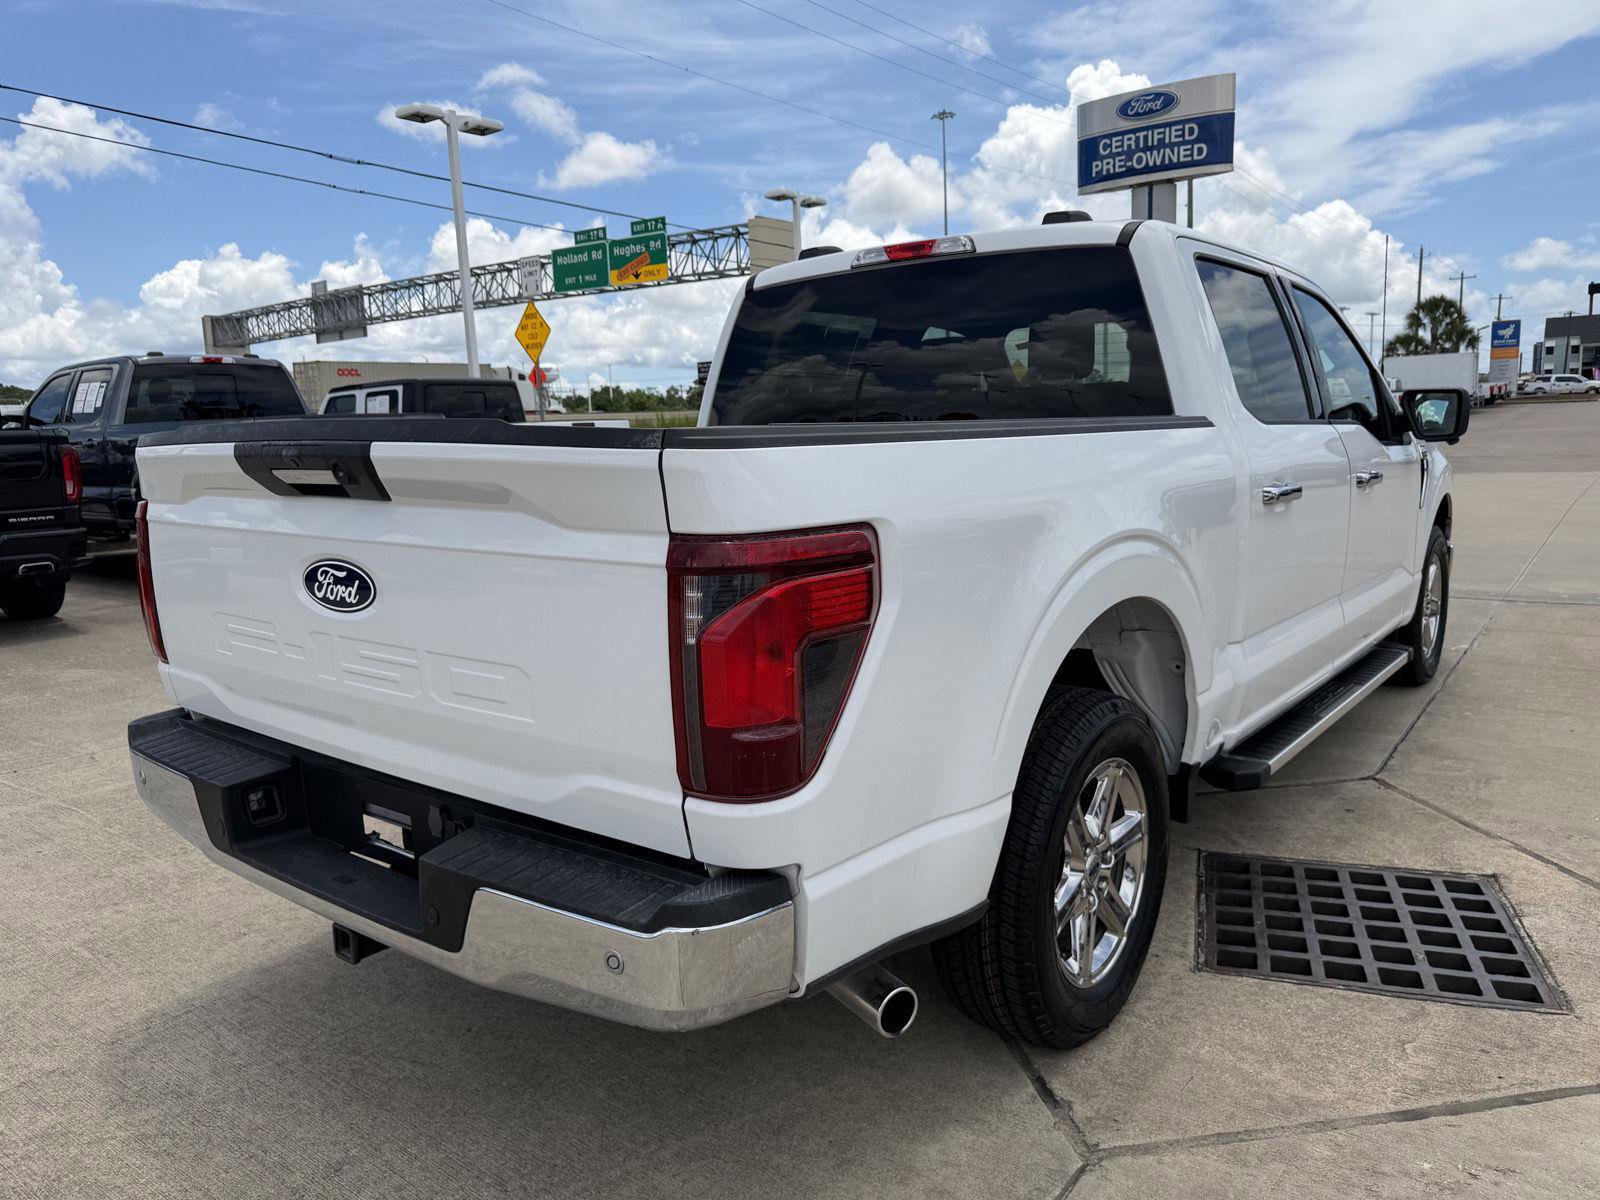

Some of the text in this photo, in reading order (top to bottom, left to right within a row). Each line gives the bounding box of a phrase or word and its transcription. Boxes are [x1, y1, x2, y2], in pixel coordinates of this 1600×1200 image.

[1127, 93, 1164, 115] Ford
[1099, 123, 1199, 156] CERTIFIED
[1092, 143, 1207, 177] PRE-OWNED
[633, 223, 645, 232] EXIT
[557, 249, 603, 265] Holland Rd
[613, 239, 662, 257] Hughes Rd
[565, 276, 576, 285] EXIT
[584, 274, 597, 282] MILE
[644, 269, 661, 277] ONLY
[337, 367, 361, 377] OOCL
[313, 566, 360, 604] Ford
[210, 611, 535, 723] F-150
